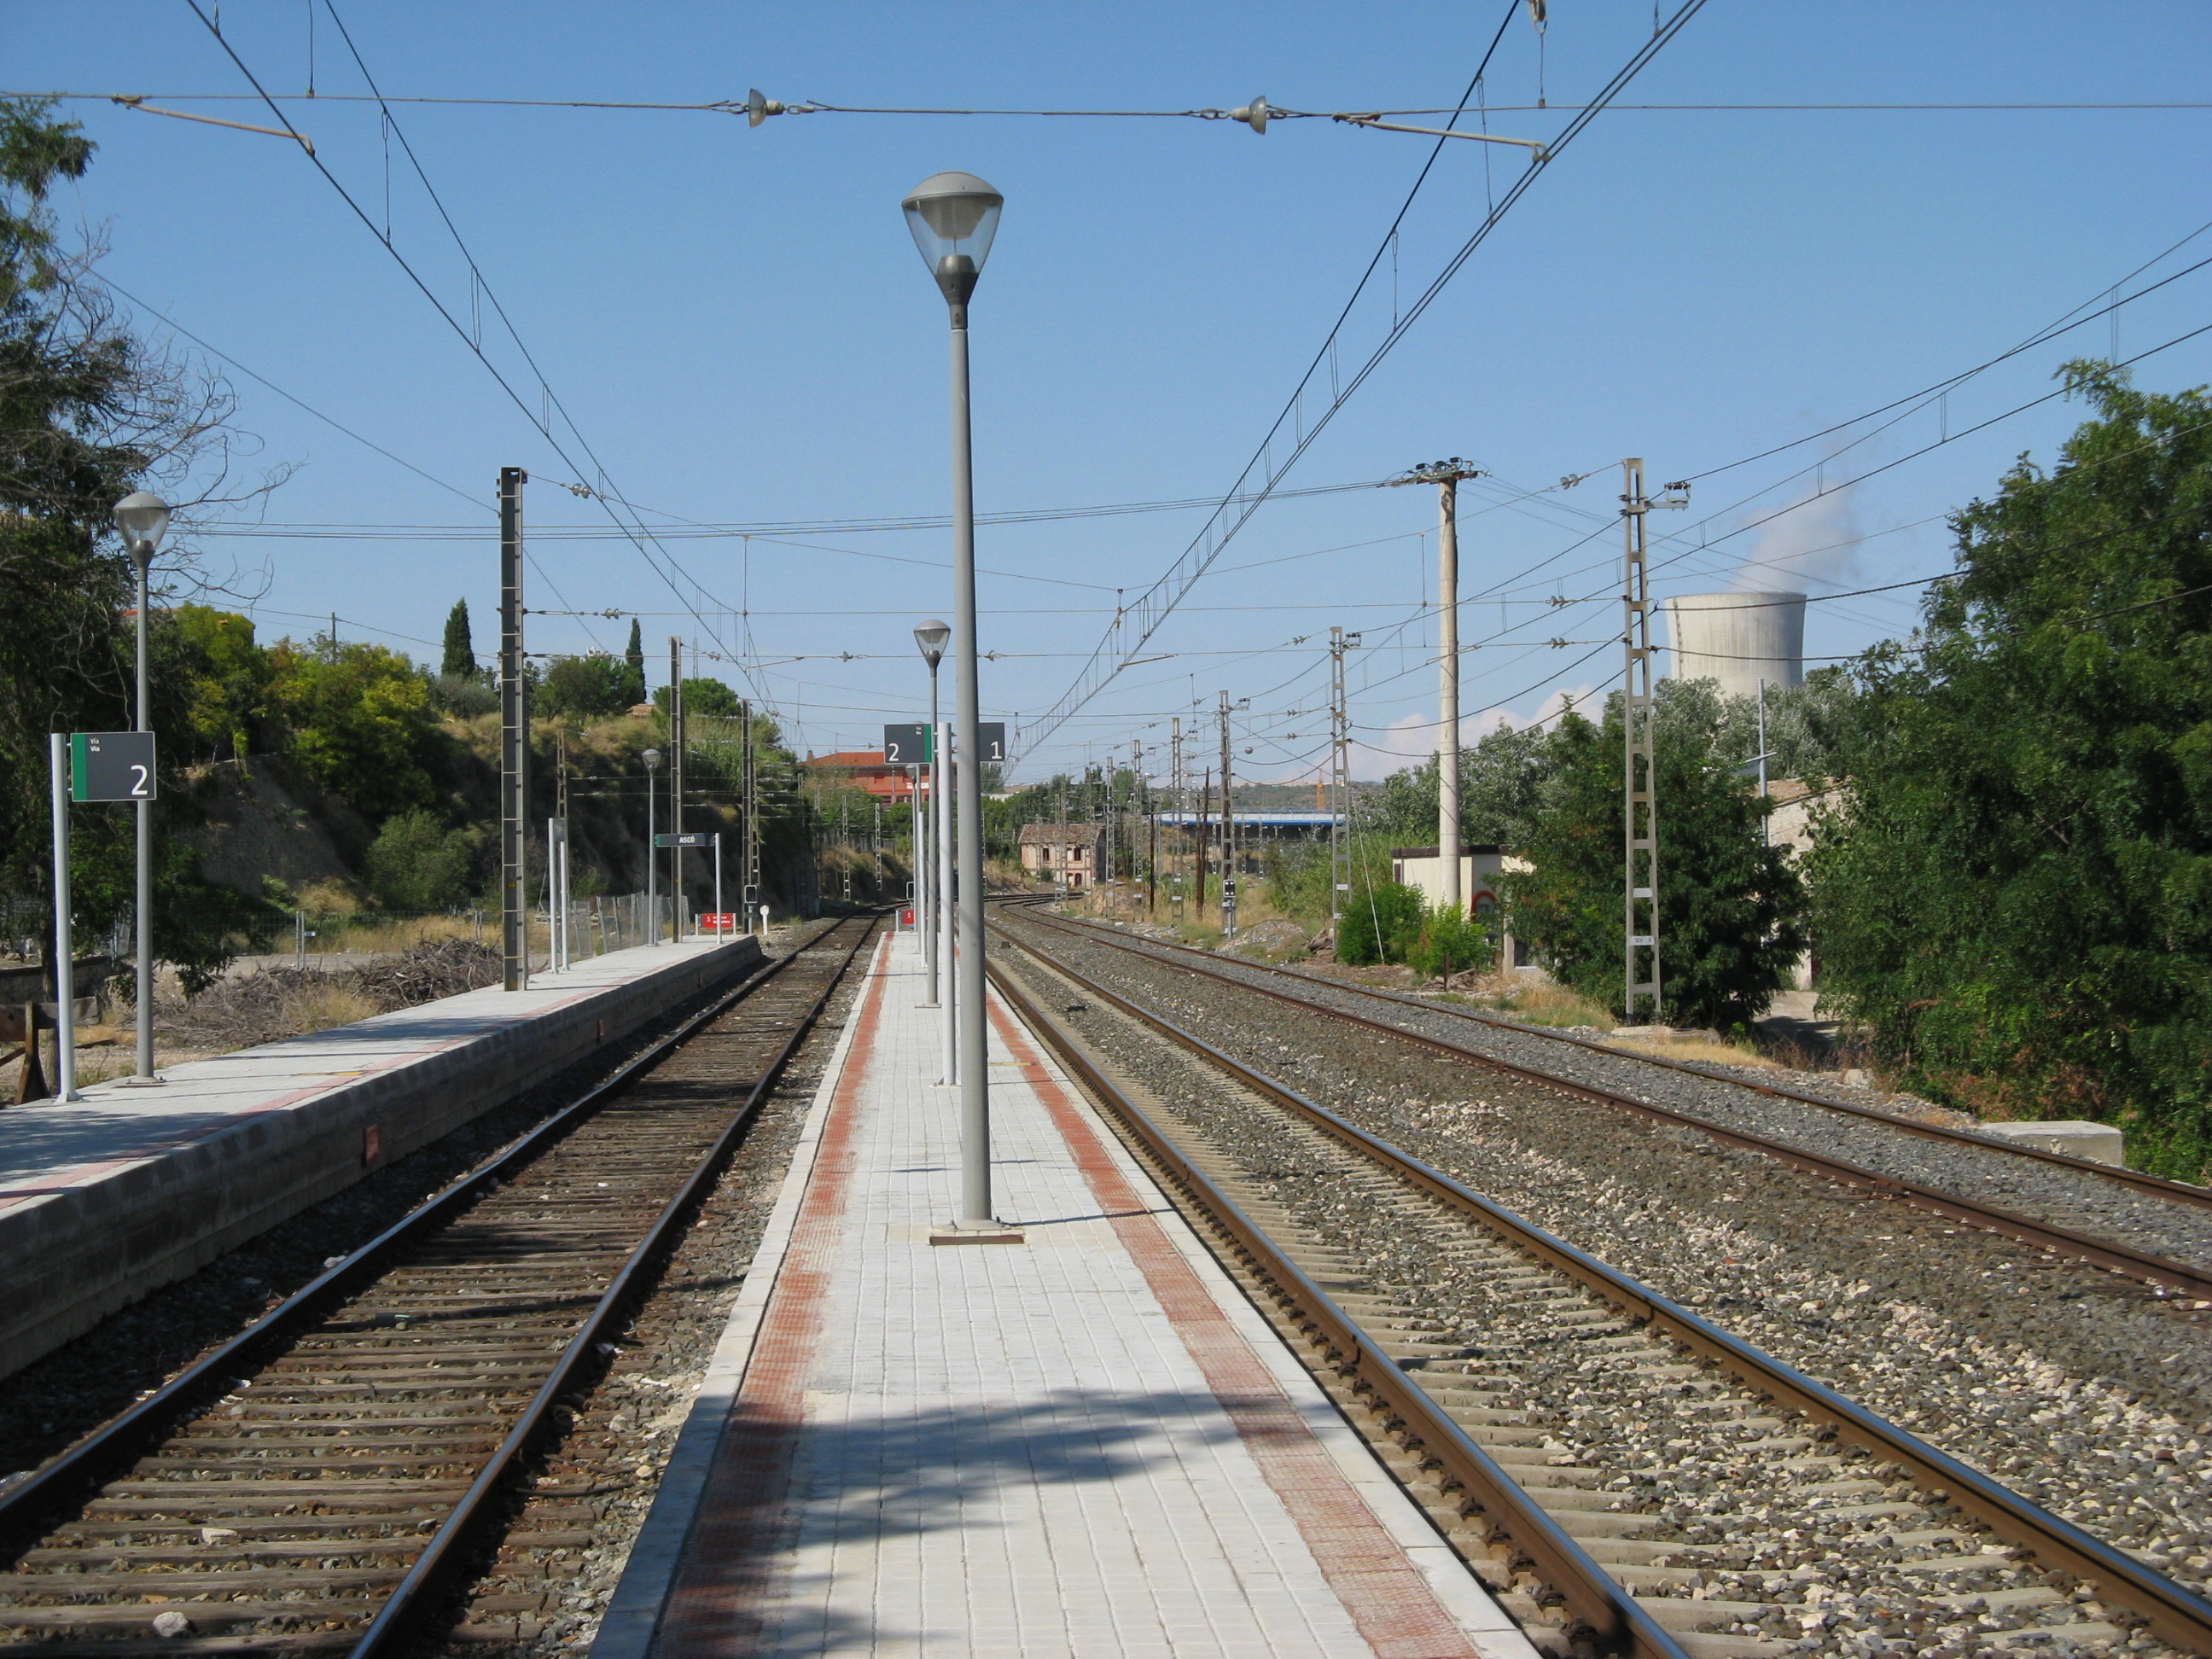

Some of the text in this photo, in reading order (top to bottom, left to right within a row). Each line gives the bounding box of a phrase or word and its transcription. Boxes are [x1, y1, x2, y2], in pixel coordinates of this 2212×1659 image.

[888, 742, 900, 762] 2
[990, 740, 1003, 760] 1
[131, 765, 148, 795] 2
